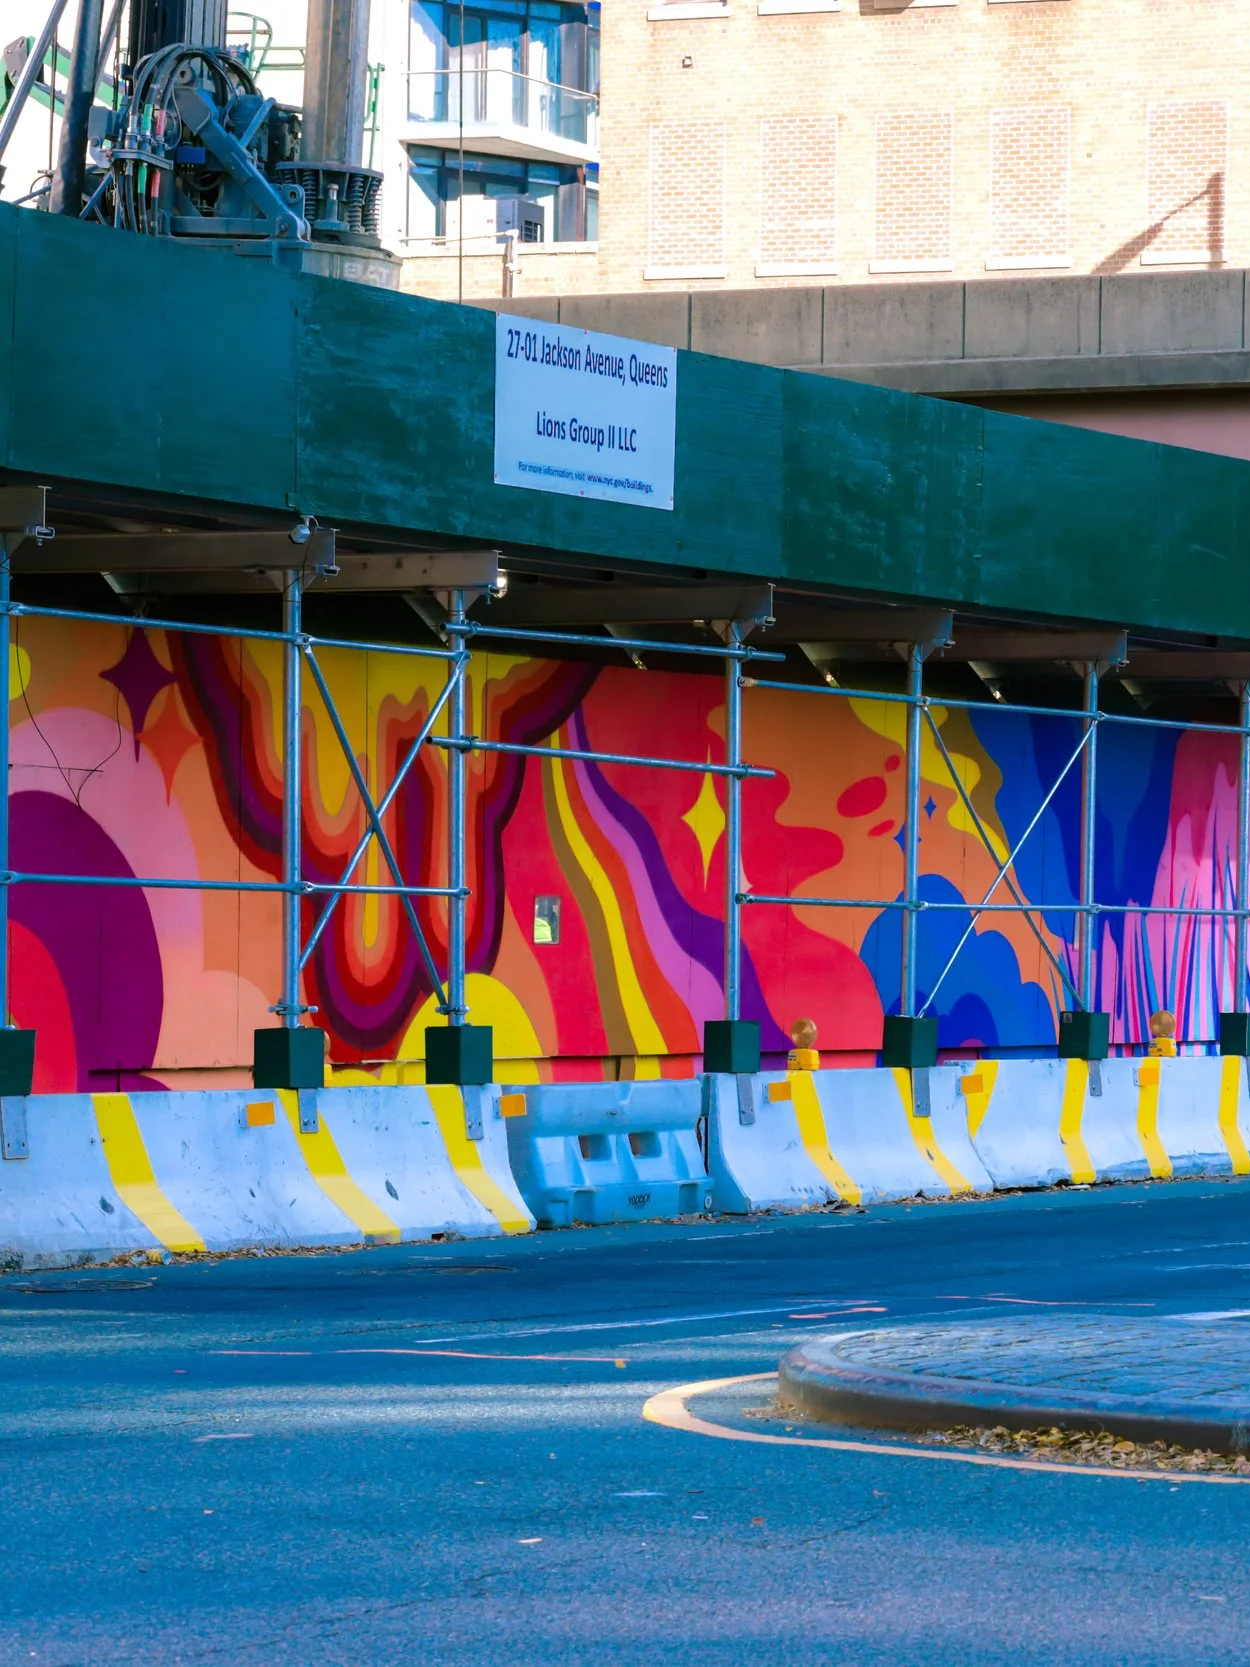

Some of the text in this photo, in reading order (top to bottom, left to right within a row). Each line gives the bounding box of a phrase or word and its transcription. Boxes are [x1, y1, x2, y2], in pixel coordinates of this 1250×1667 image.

[507, 328, 668, 388] 27-01 Jackson Avenue, Queens
[536, 411, 637, 453] Lions Group II LLC
[518, 461, 528, 472] For
[528, 464, 542, 475] more
